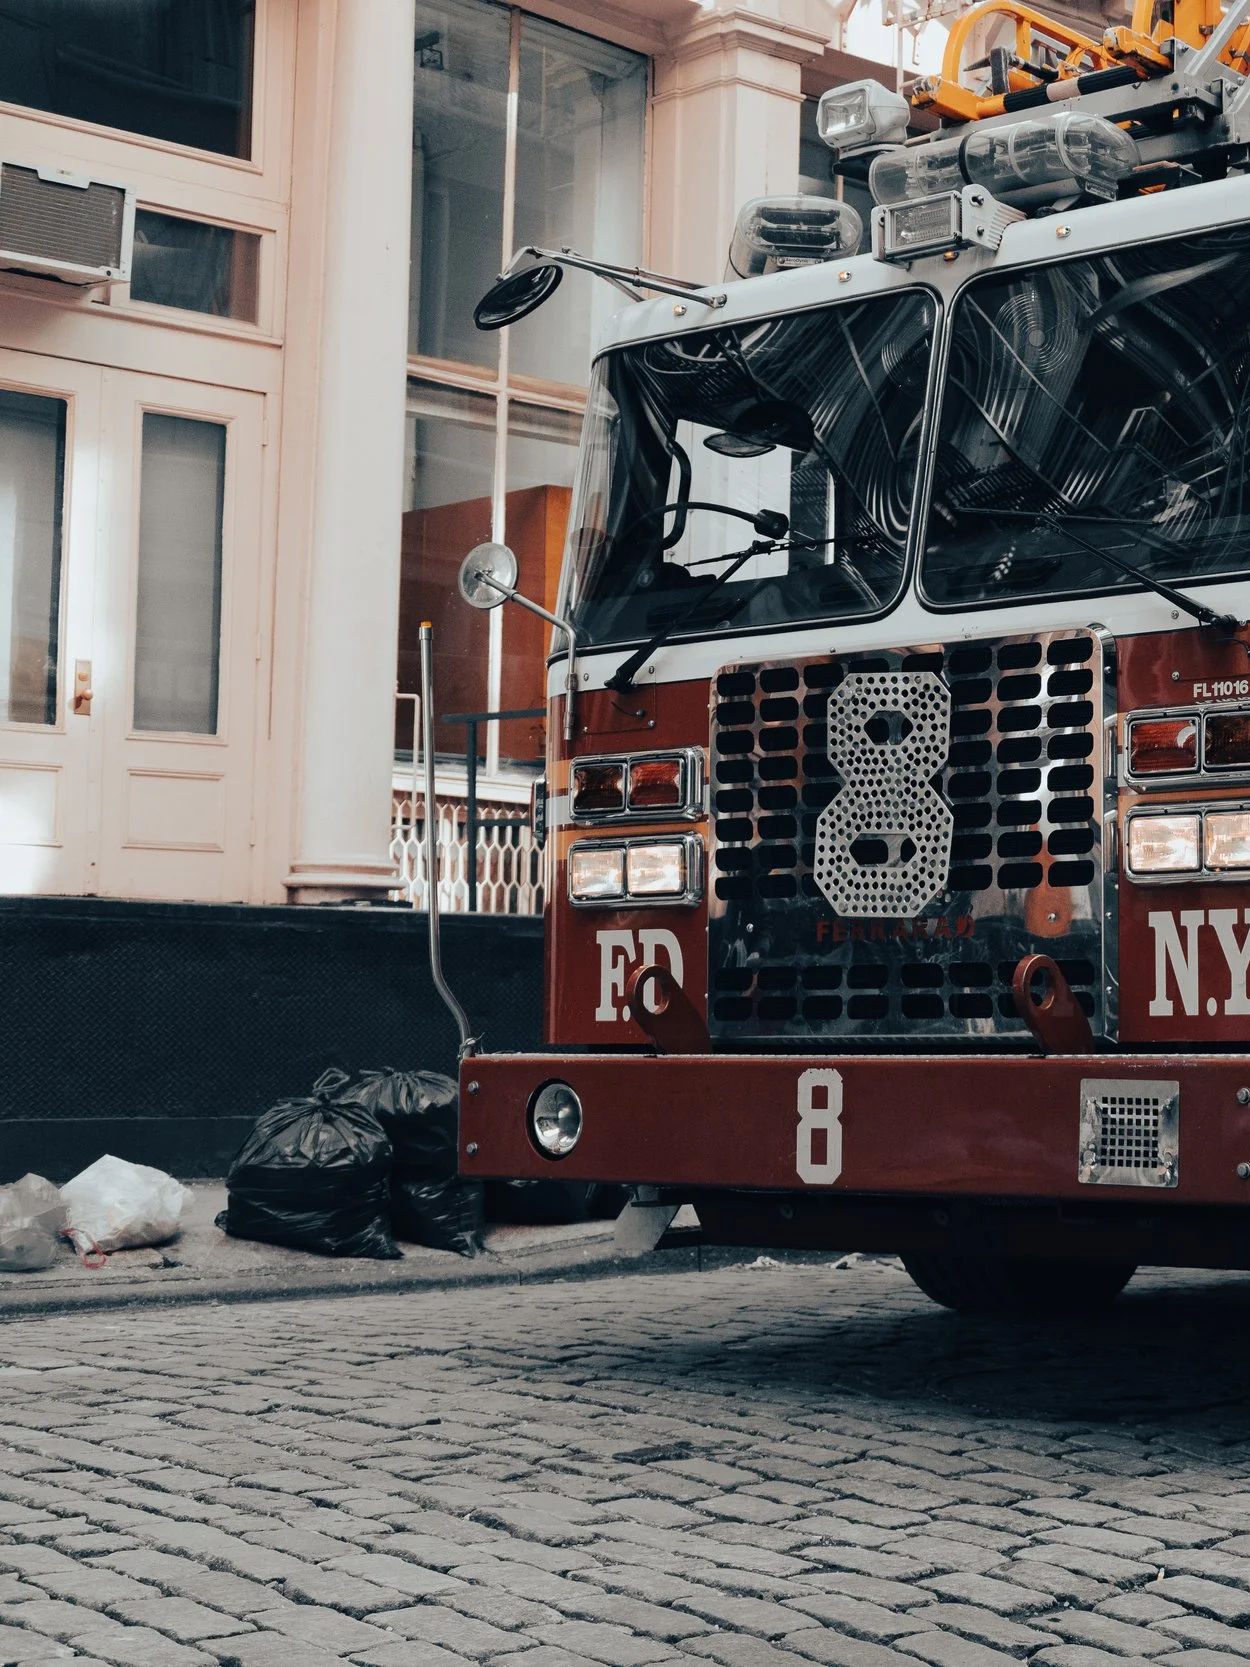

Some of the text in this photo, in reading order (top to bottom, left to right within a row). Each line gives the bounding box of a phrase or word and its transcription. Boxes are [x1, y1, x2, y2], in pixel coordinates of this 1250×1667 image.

[1193, 680, 1249, 698] FL11016
[813, 671, 954, 918] 8
[796, 1068, 843, 1184] 8
